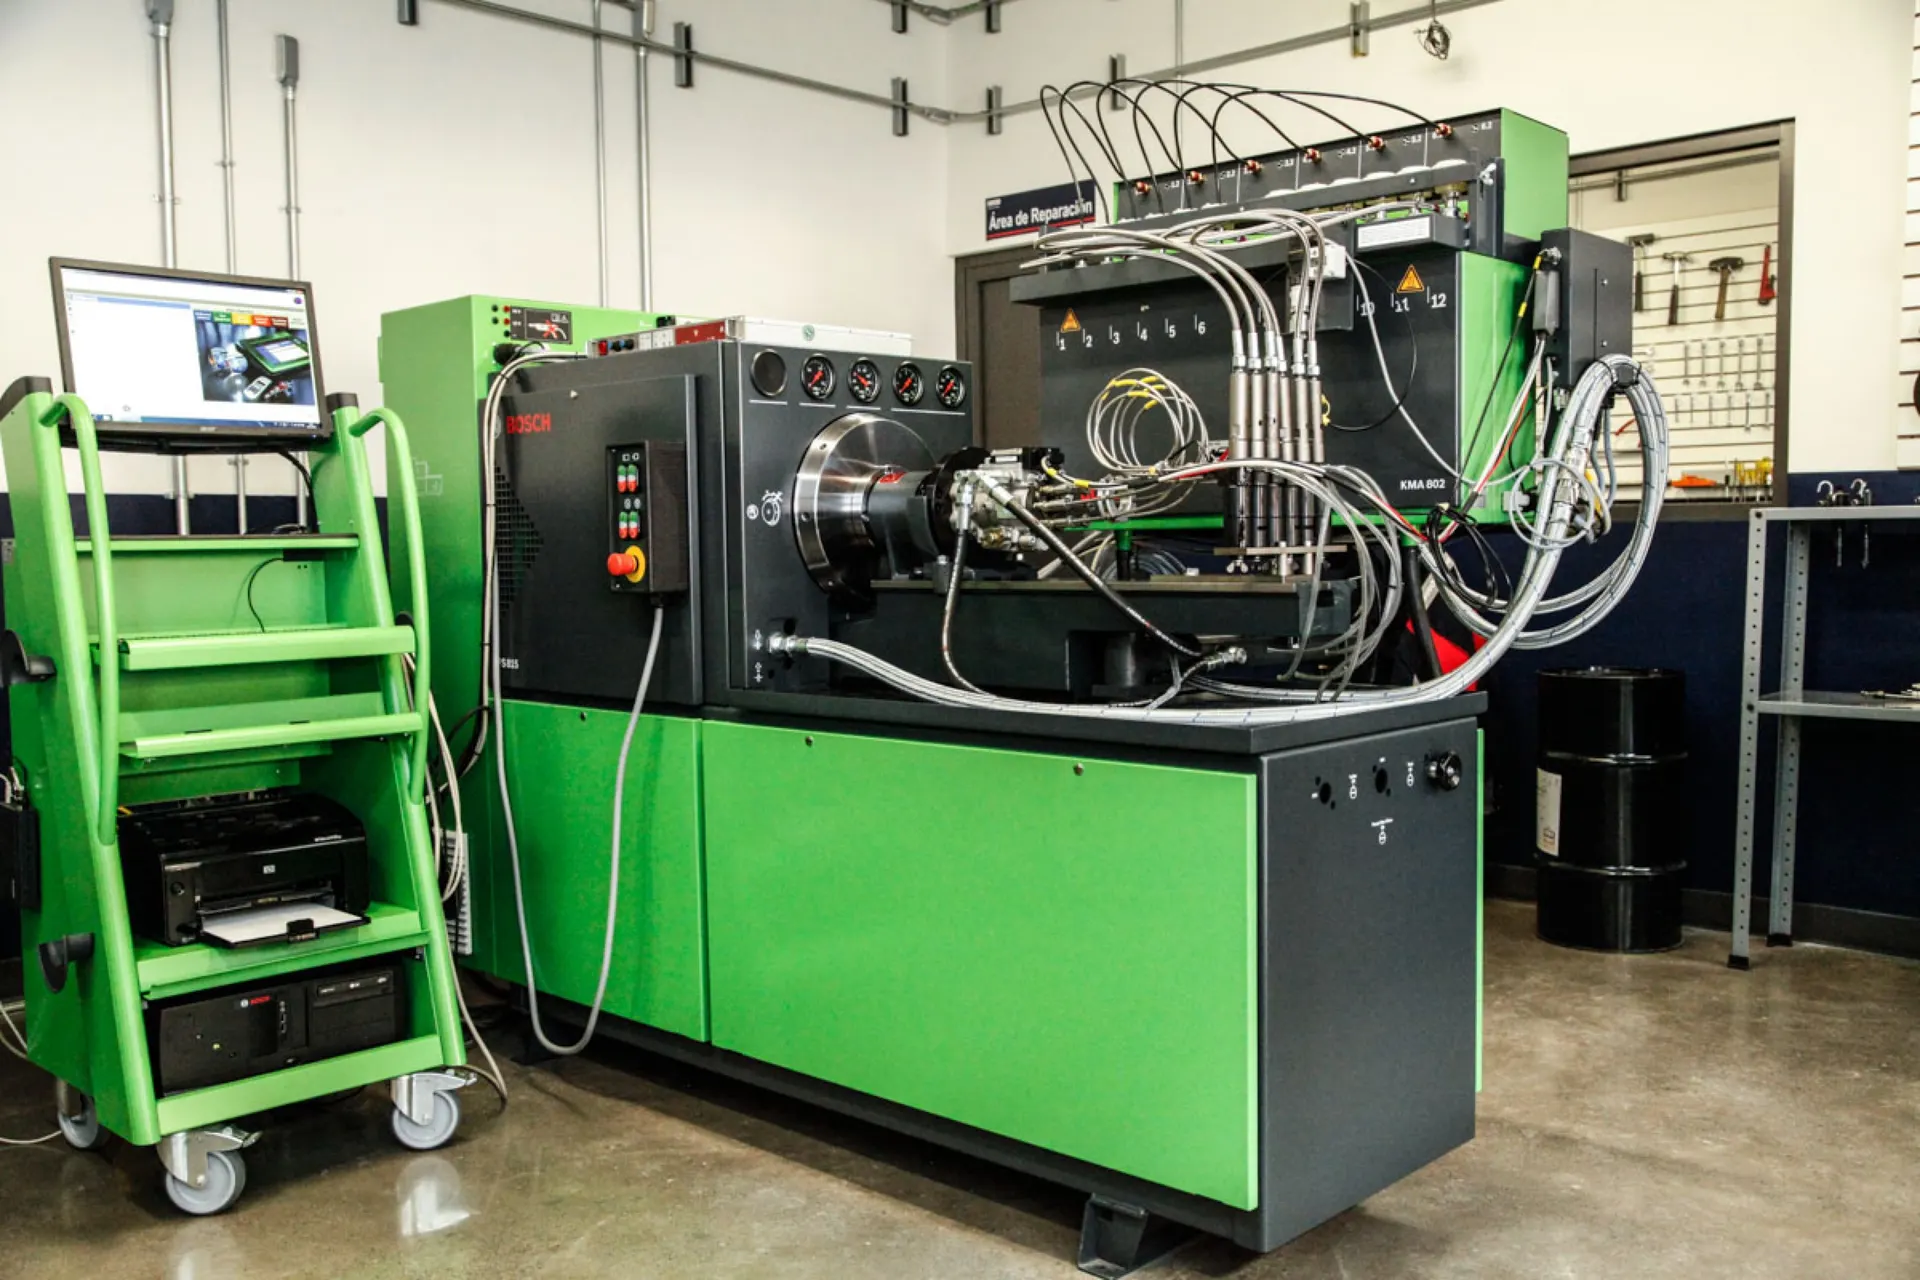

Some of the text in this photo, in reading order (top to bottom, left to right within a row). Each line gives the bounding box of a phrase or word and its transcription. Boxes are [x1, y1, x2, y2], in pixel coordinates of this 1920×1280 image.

[989, 211, 1014, 231] Área
[1015, 210, 1029, 226] de
[1394, 298, 1410, 312] 11
[1431, 293, 1447, 308] 12
[1059, 321, 1206, 351] 1 2 3 4 5 6
[506, 412, 551, 434] BOSCH
[1400, 478, 1446, 490] KMA 802
